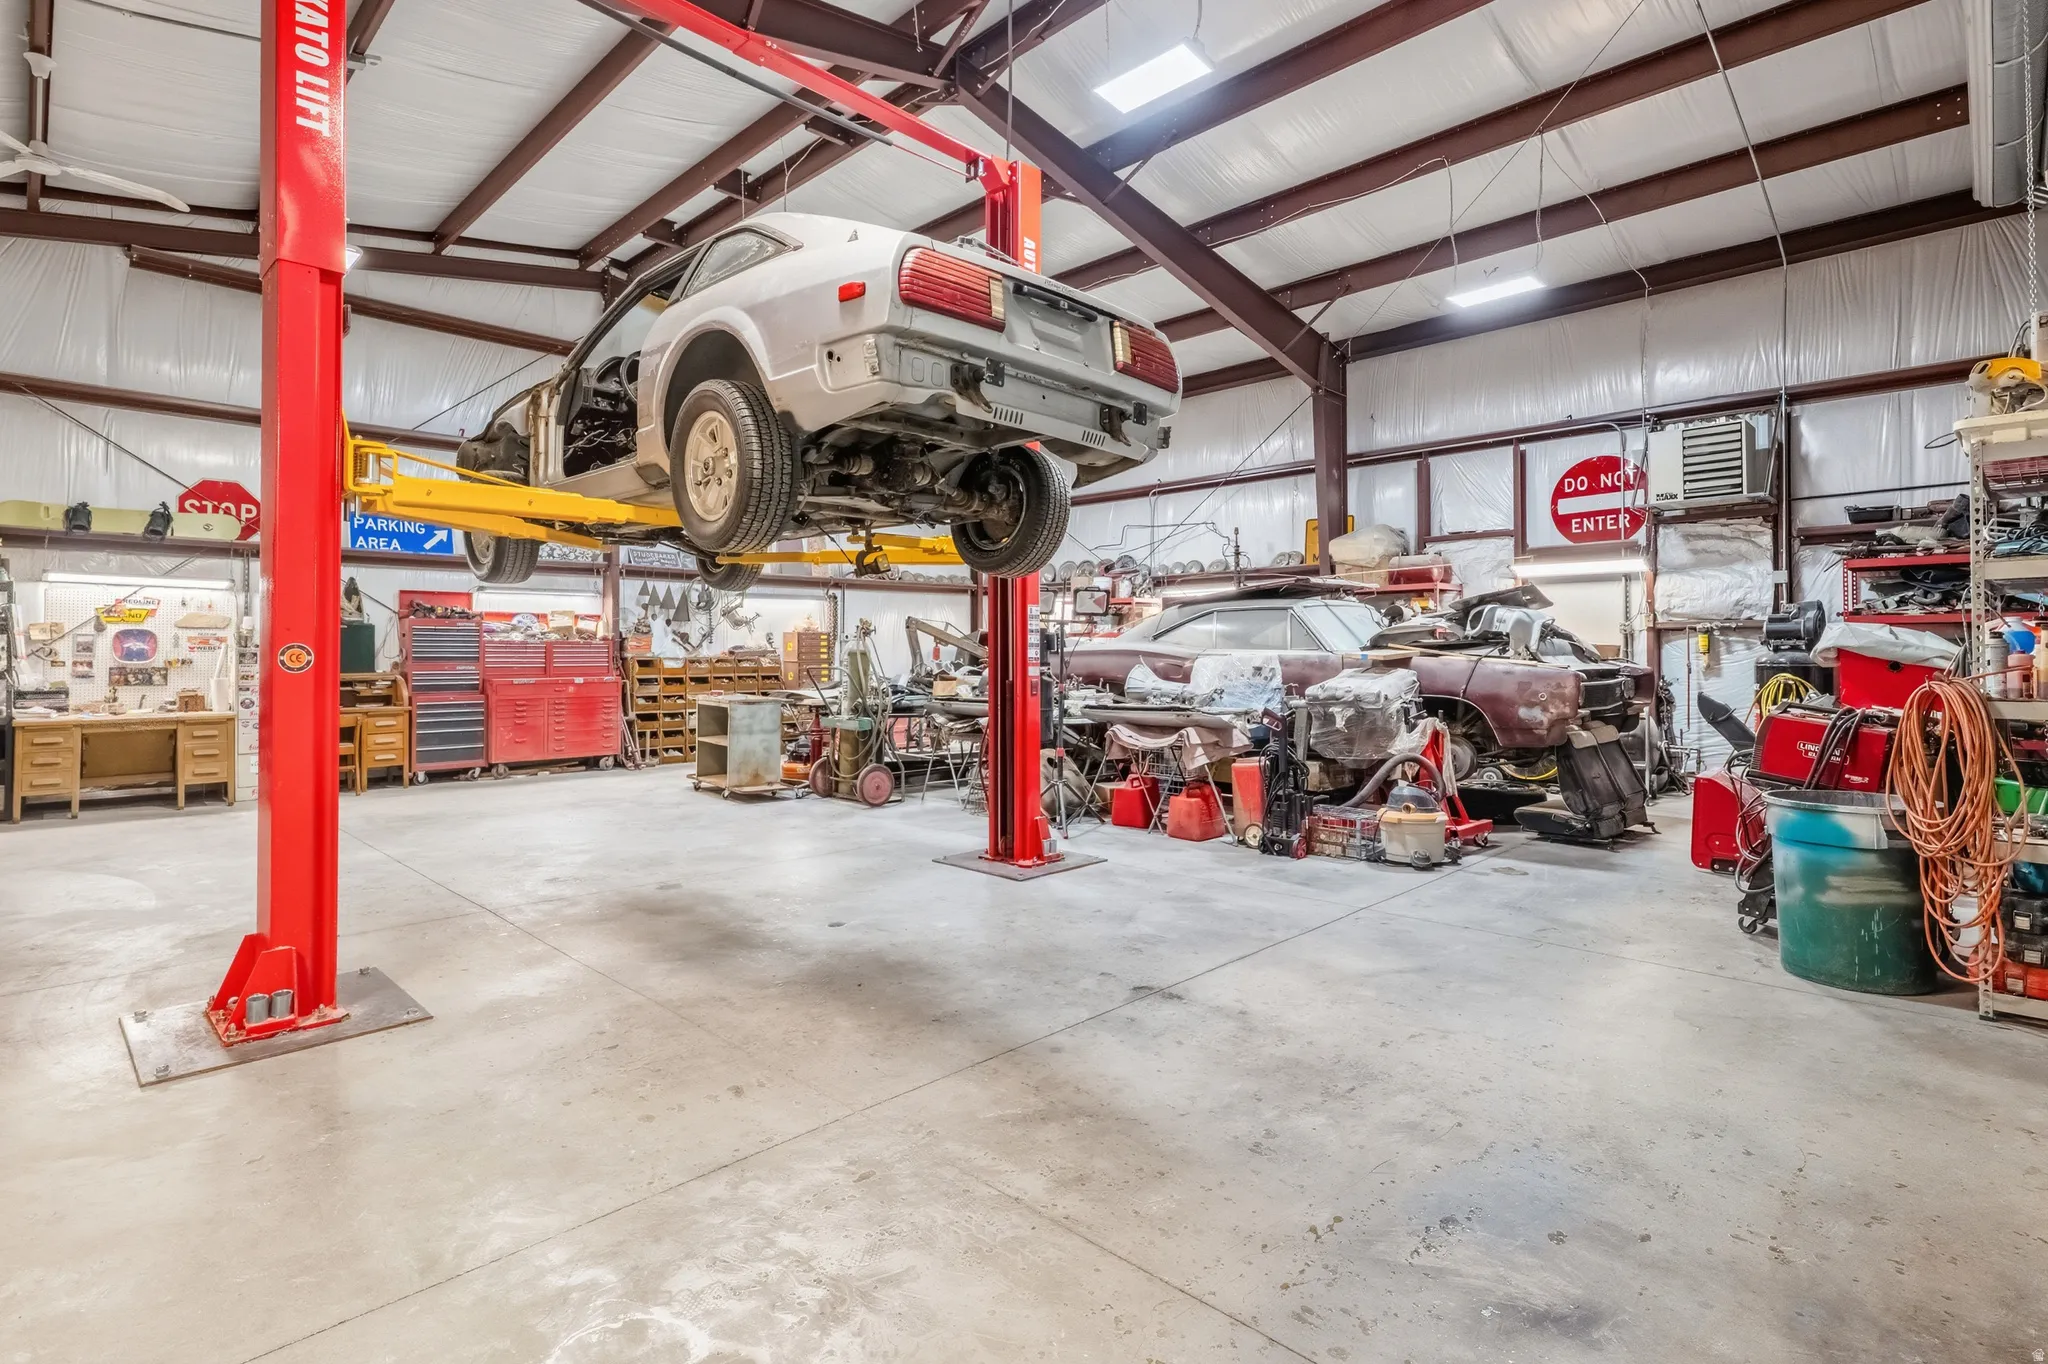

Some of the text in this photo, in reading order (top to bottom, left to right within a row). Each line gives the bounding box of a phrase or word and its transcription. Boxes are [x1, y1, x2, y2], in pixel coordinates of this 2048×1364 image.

[296, 70, 330, 137] LIFT
[1564, 469, 1637, 493] DO NOT
[184, 499, 258, 528] STOP
[353, 517, 426, 535] PARKING
[1571, 514, 1631, 533] ENTER
[355, 536, 402, 551] AREA
[289, 653, 303, 664] CE
[1800, 743, 1841, 756] LINCN
